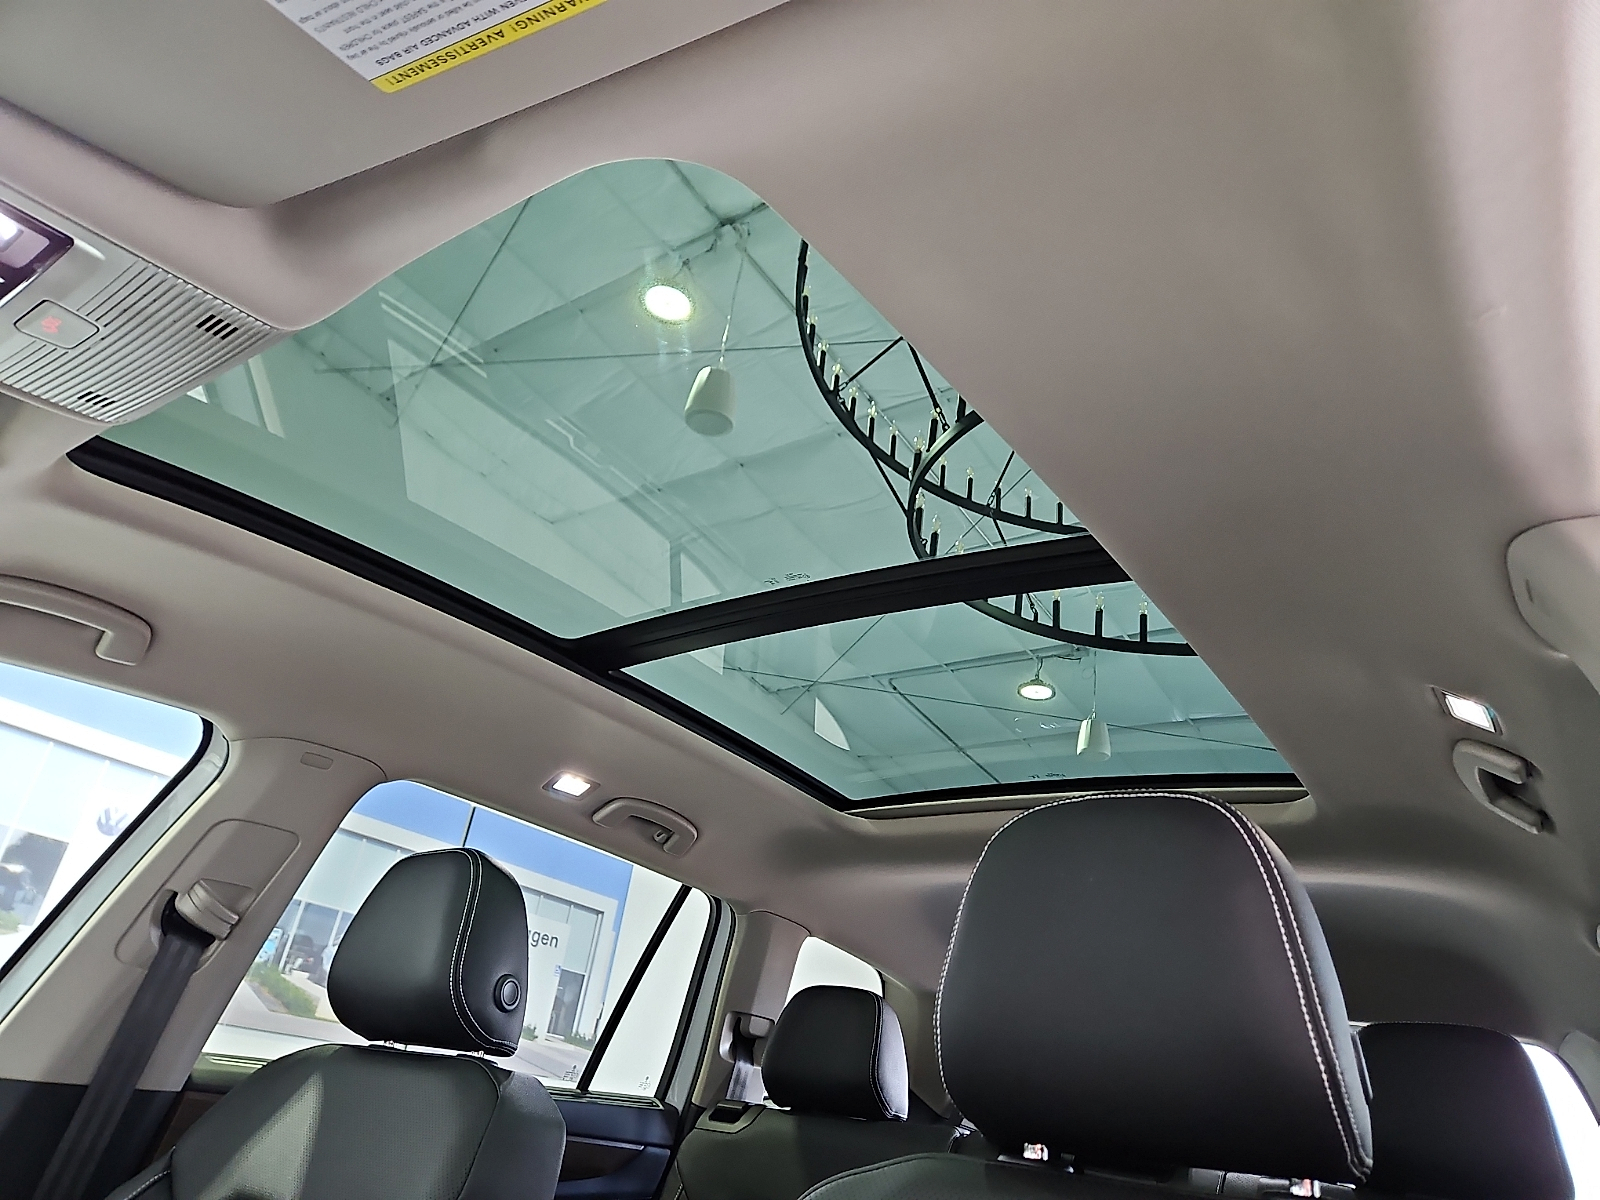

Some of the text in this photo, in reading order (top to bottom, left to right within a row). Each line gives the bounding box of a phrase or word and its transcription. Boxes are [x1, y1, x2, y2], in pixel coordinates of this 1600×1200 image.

[471, 7, 500, 23] WITH
[419, 19, 471, 47] ADVANCED
[385, 0, 589, 86] ARNING! AVERTISSEMENT!
[402, 43, 419, 55] AIR
[375, 51, 403, 67] BAGS
[528, 929, 559, 949] gen
